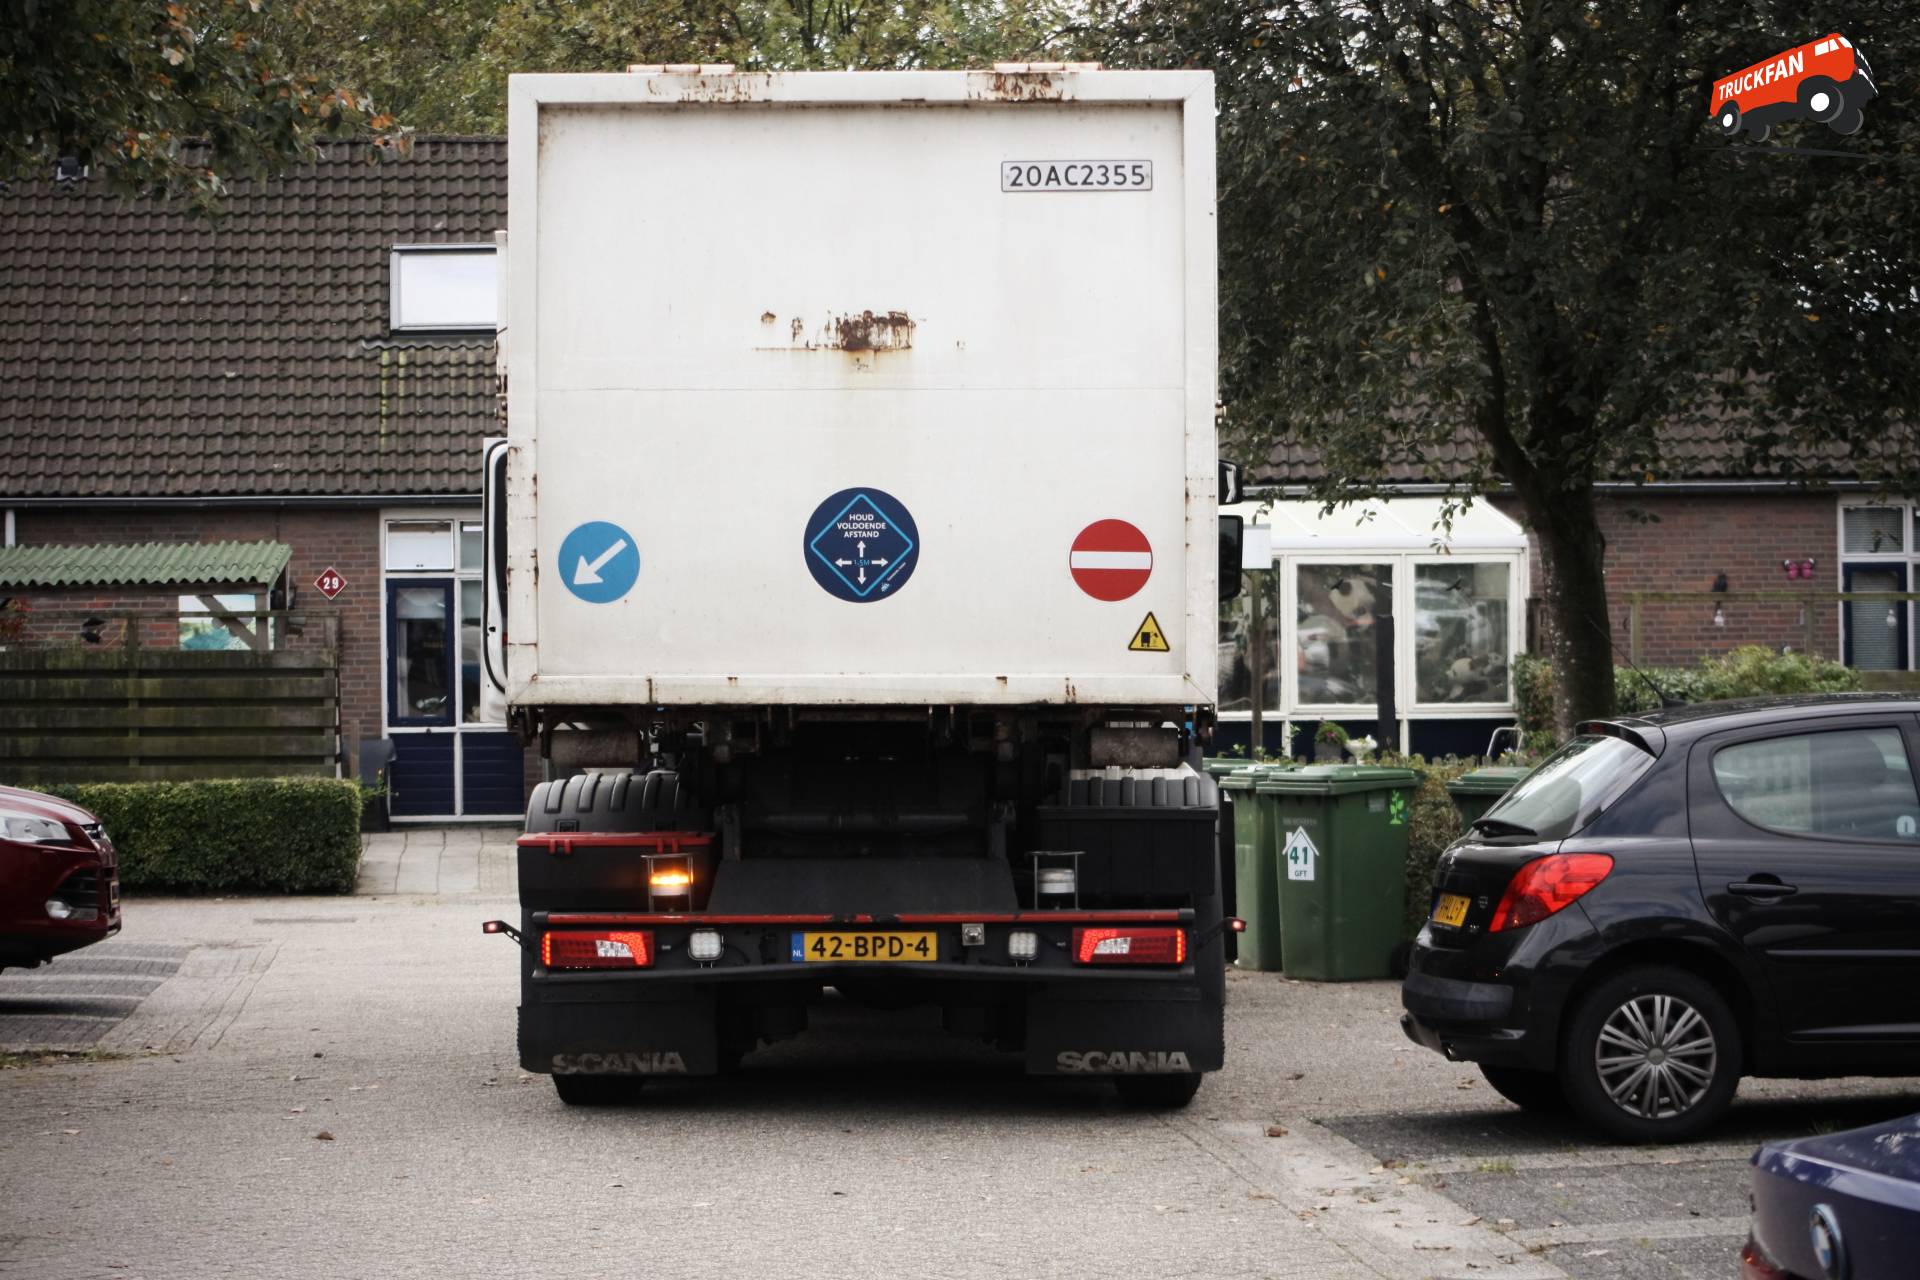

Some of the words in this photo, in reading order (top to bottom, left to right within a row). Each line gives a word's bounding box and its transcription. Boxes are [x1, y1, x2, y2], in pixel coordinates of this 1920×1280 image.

[1009, 164, 1146, 187] 20AC2355
[837, 522, 886, 530] VOLDOENDE
[849, 513, 874, 521] HOUD
[323, 577, 339, 590] 29
[1289, 846, 1308, 865] 41
[792, 949, 803, 957] NL
[811, 936, 930, 958] 42-BPD-4
[551, 1051, 688, 1074] SCANIA
[1056, 1051, 1193, 1073] SCANIA
